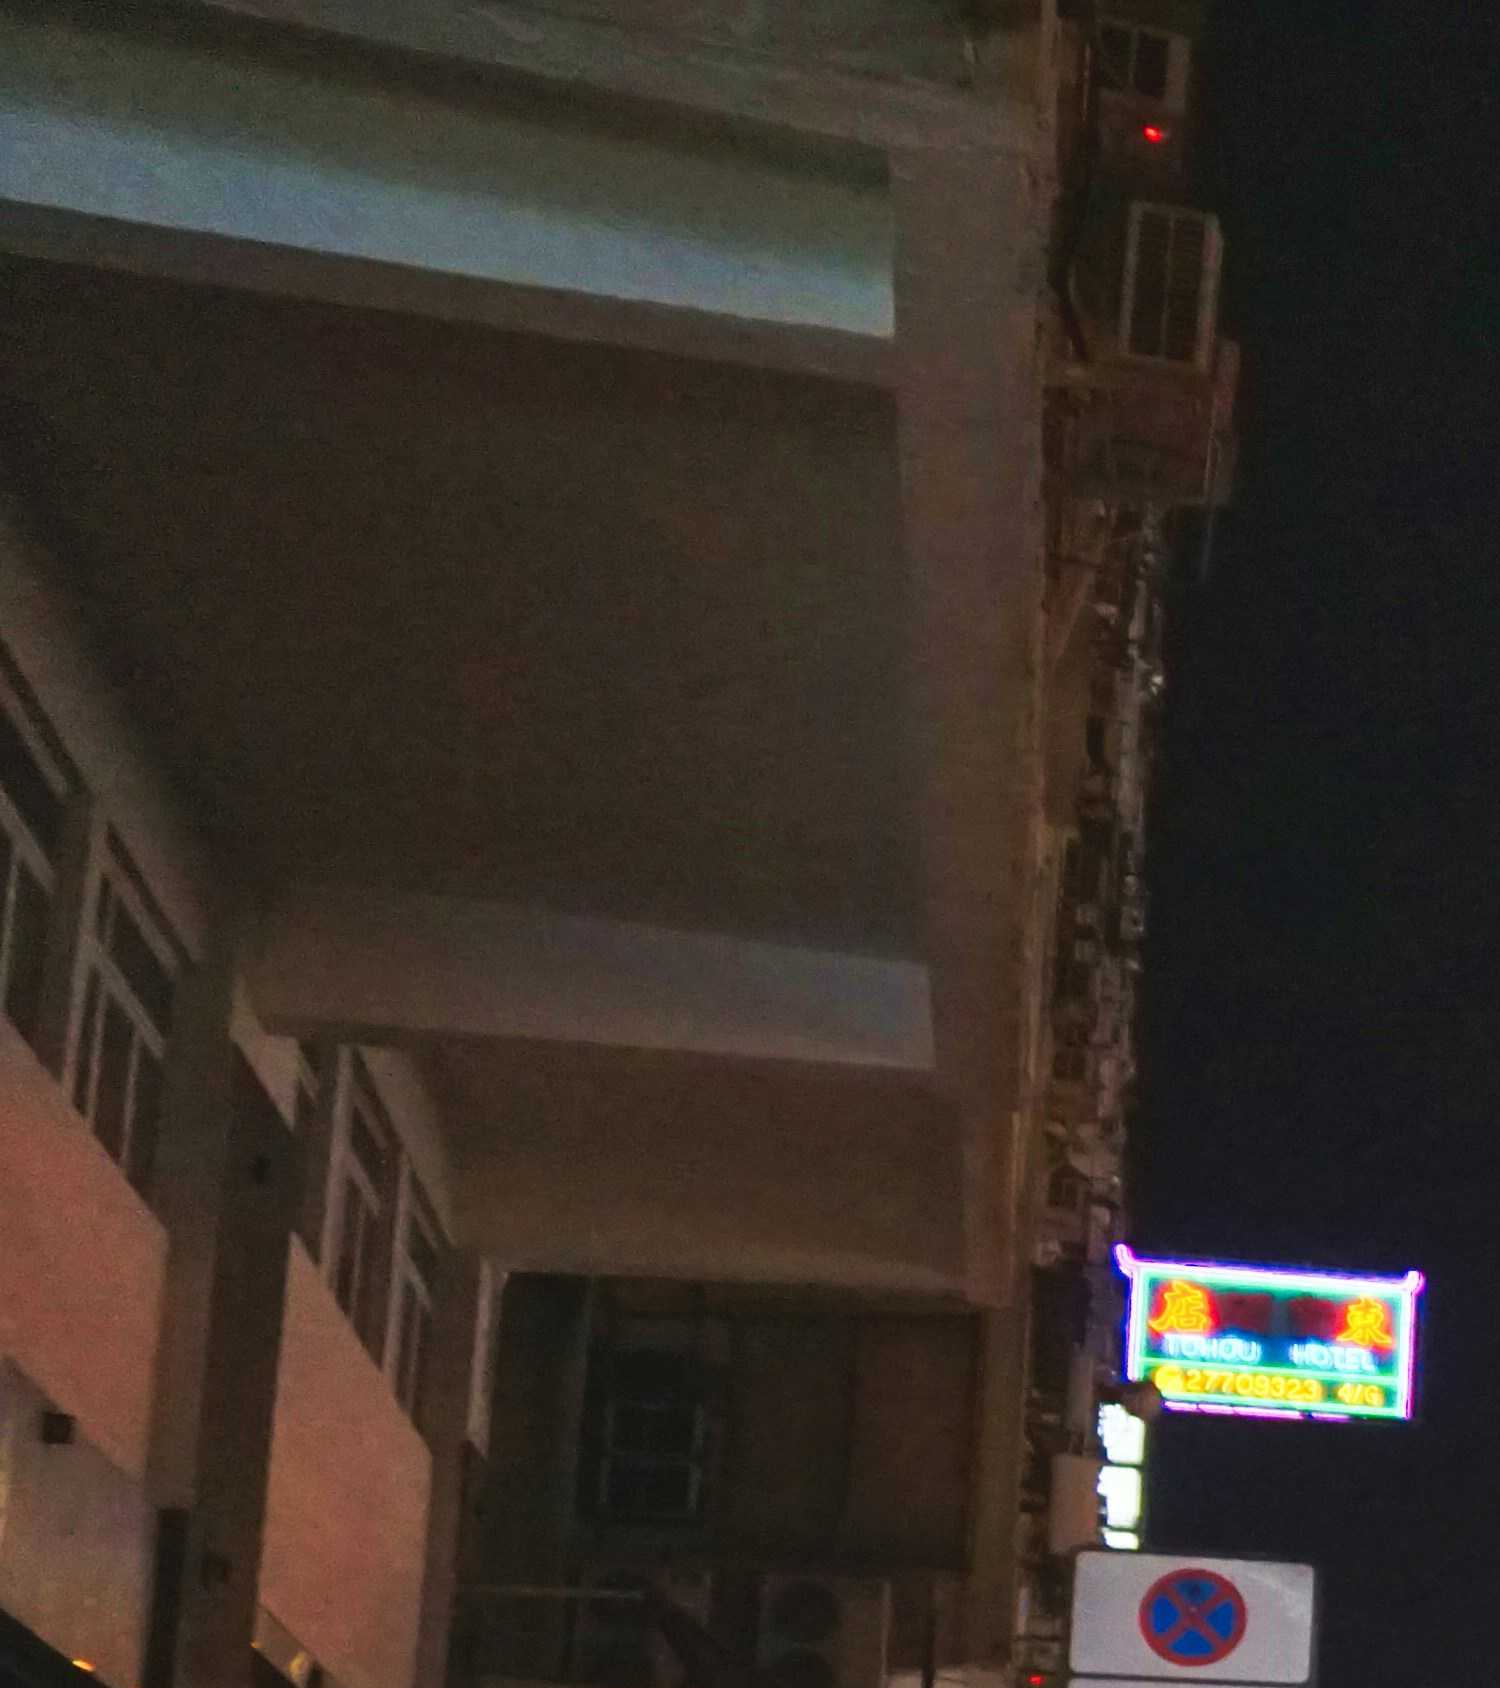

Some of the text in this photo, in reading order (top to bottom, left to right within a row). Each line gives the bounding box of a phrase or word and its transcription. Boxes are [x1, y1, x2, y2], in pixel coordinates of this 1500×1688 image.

[1288, 1341, 1378, 1374] HOTEL
[1186, 1369, 1386, 1408] 27709323 4/G
